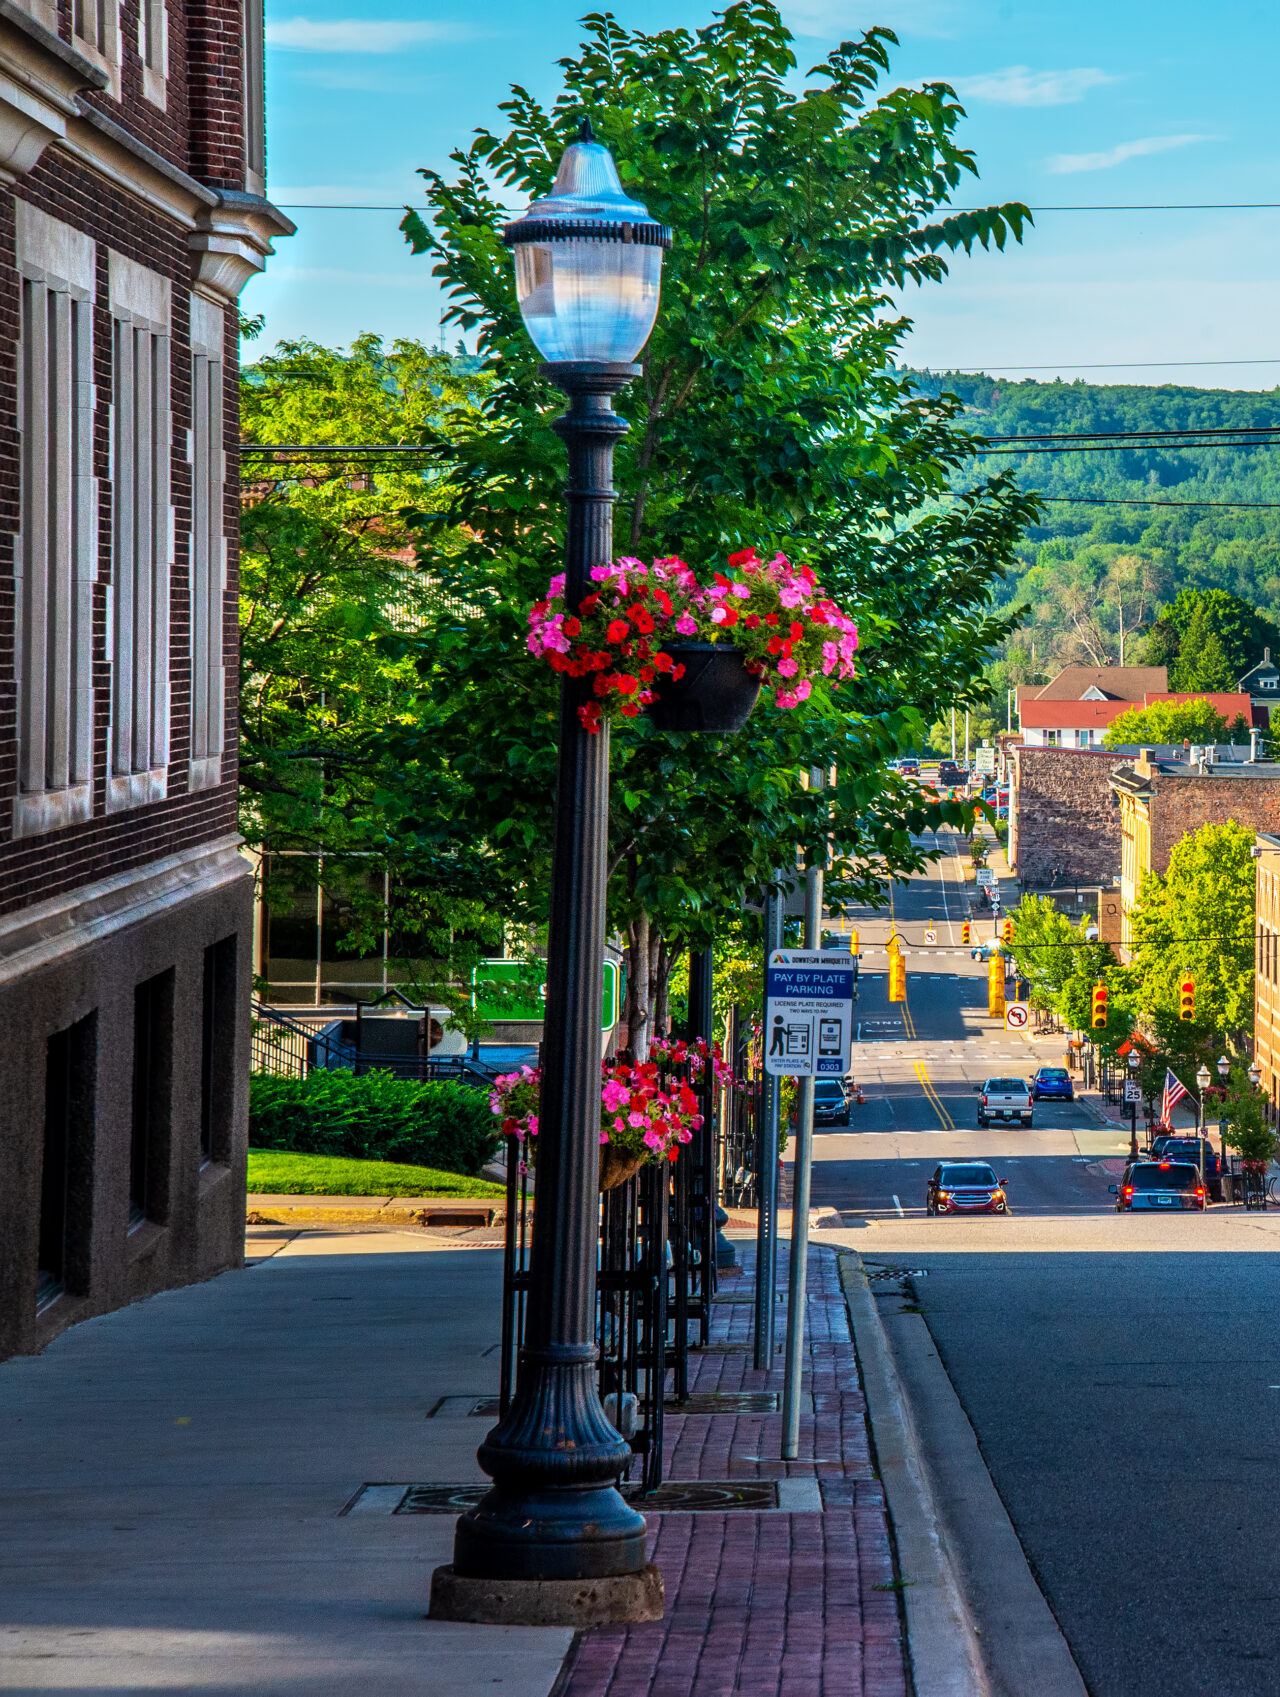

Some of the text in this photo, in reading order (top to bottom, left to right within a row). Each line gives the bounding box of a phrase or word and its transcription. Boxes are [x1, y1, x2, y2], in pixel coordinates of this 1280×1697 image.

[774, 973, 846, 983] PAY BY PLATE
[786, 985, 834, 994] PARKING
[820, 1063, 840, 1071] 0303
[1127, 1091, 1140, 1099] 25
